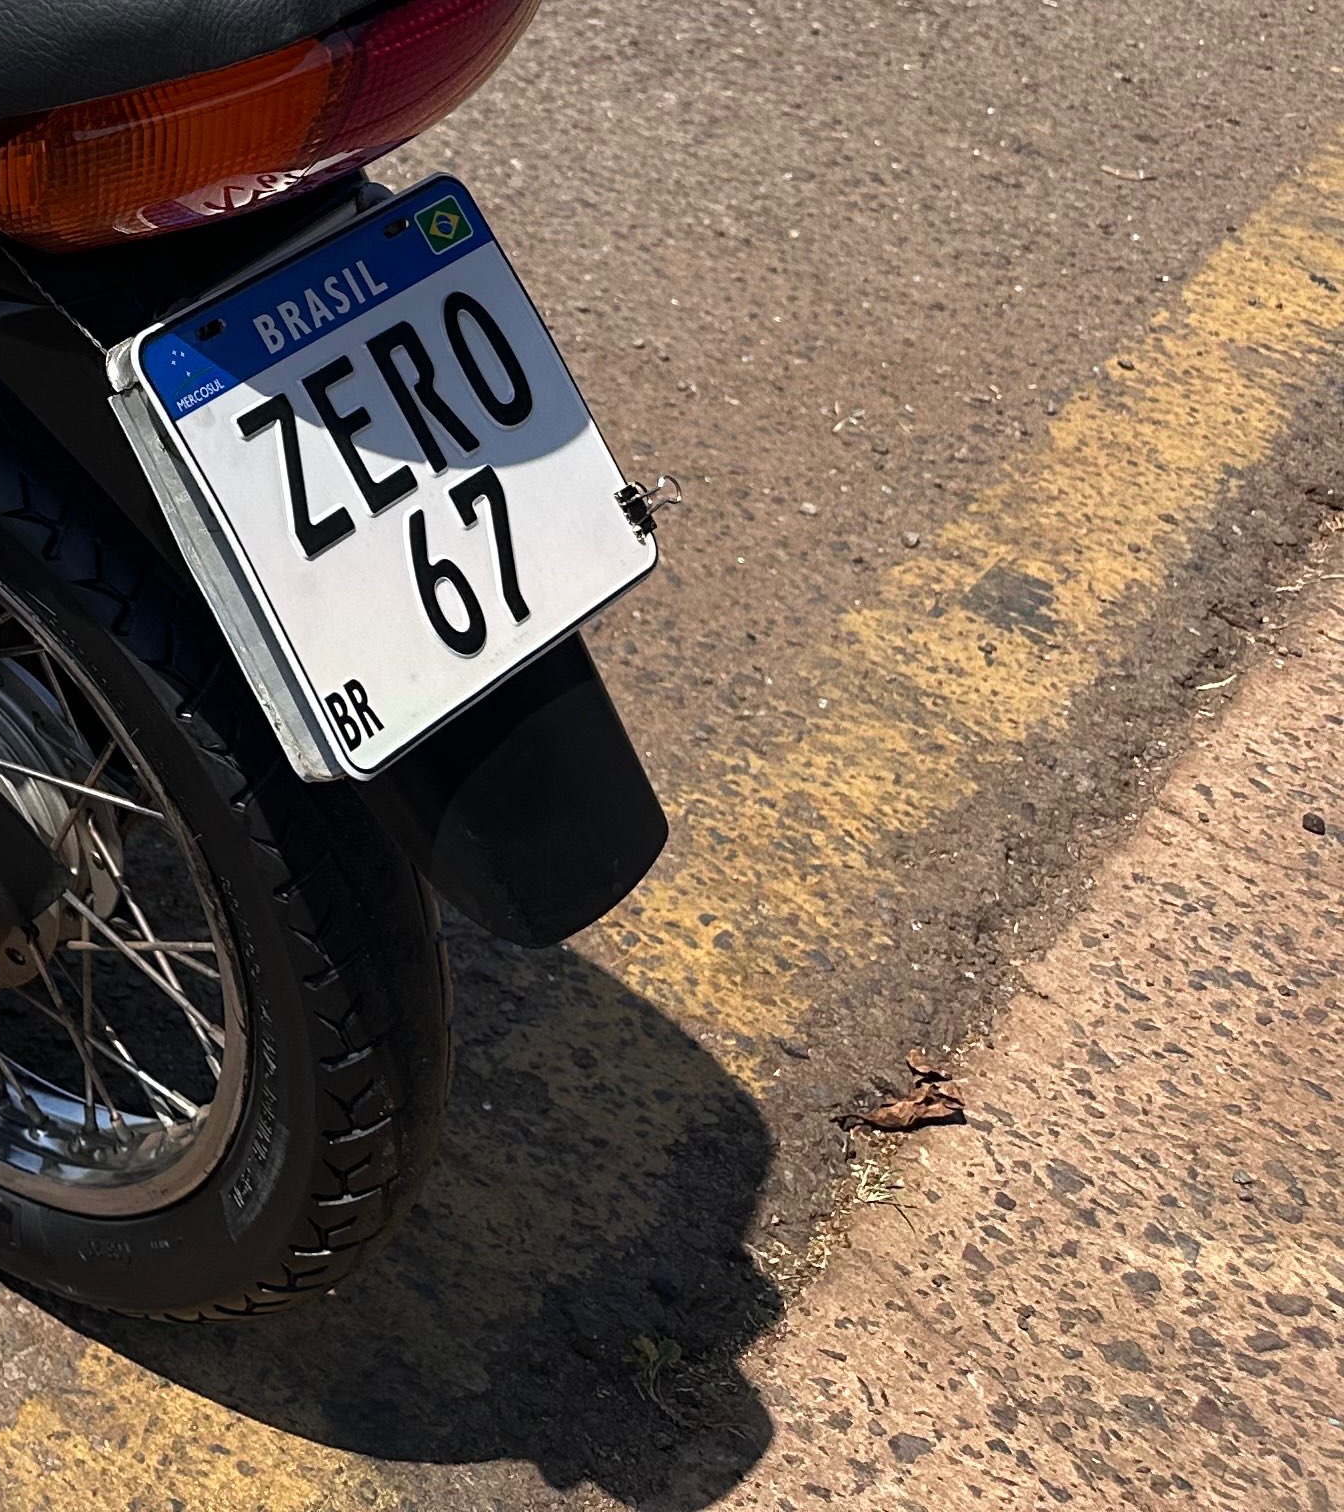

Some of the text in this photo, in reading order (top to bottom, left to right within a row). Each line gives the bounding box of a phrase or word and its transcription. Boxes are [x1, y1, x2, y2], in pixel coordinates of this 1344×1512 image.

[253, 259, 388, 354] BRASIL
[176, 378, 226, 413] MERCOSUL
[237, 291, 534, 559] ZERO
[408, 465, 530, 657] 67
[325, 678, 385, 752] BR
